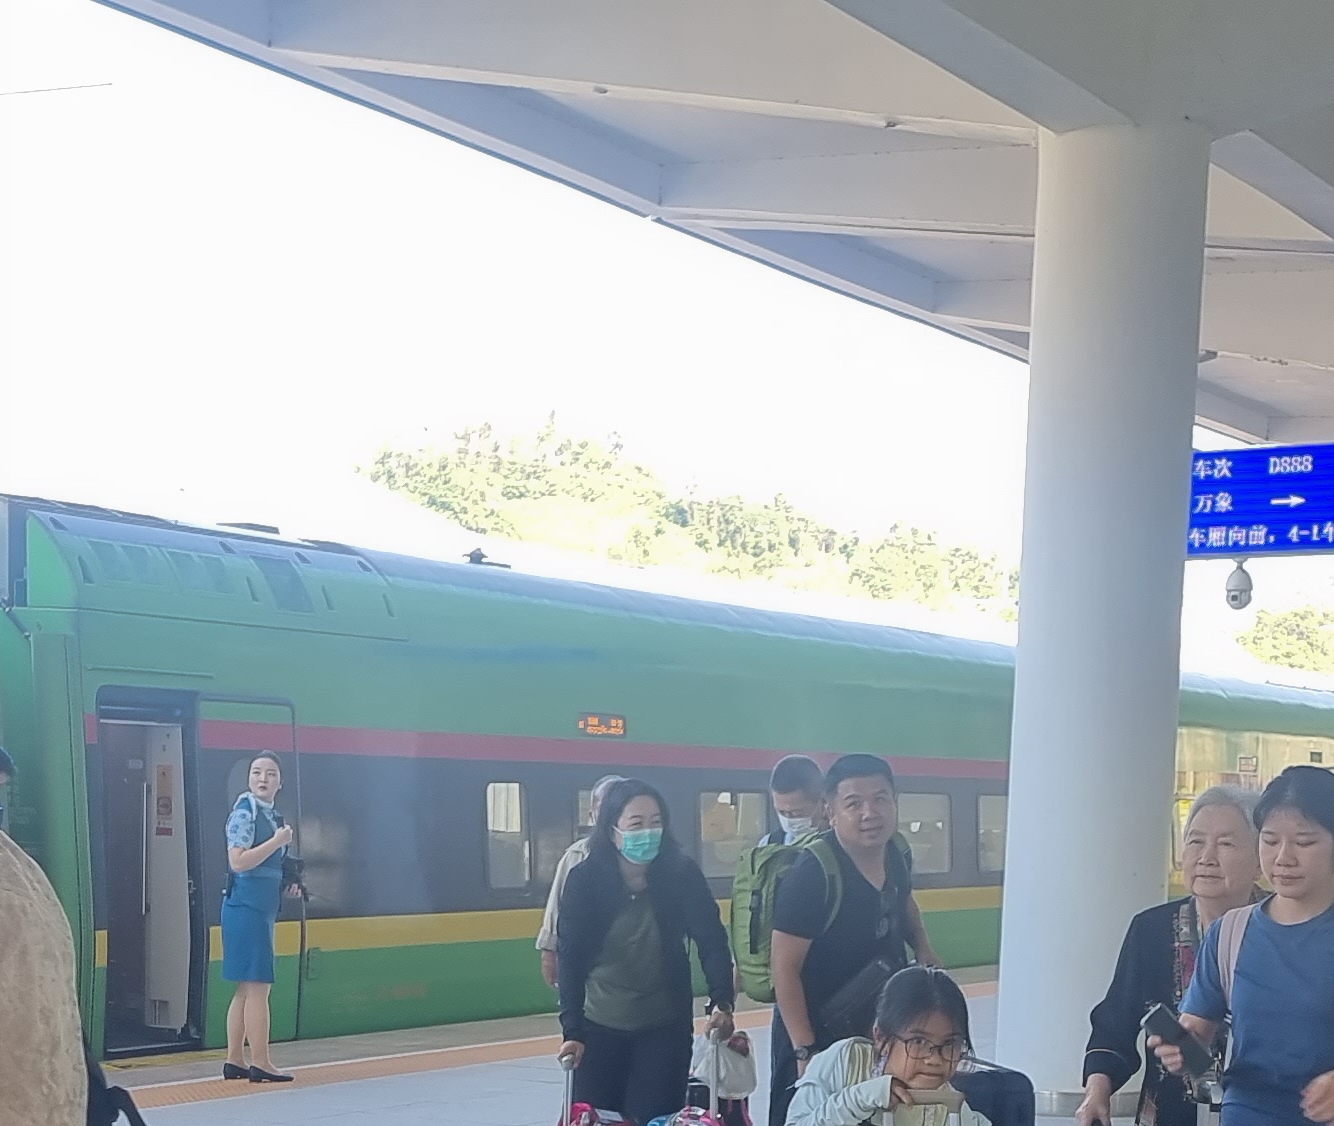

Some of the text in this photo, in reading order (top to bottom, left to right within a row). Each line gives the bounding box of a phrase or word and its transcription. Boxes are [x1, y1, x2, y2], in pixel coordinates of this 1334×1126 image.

[1192, 456, 1233, 479] 车次
[1268, 454, 1314, 475] D888
[1192, 492, 1234, 514] 万象
